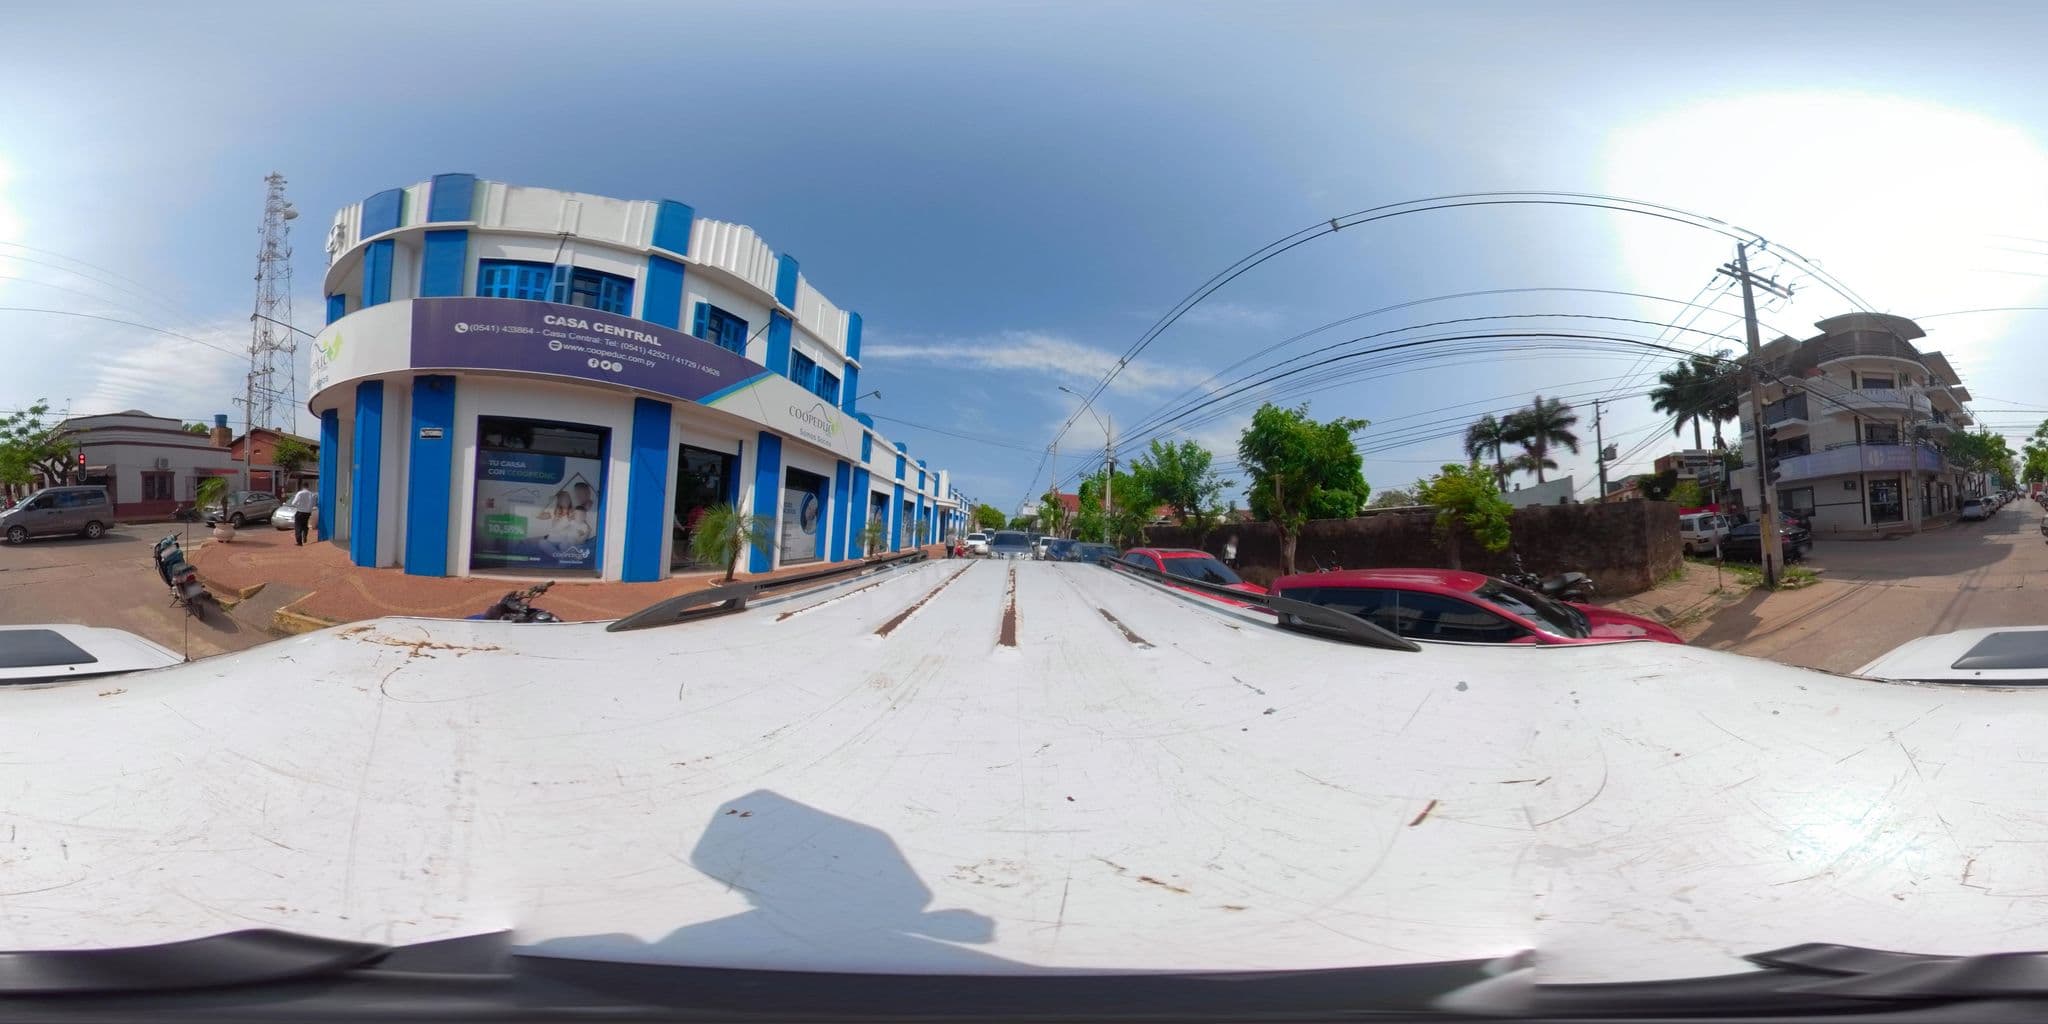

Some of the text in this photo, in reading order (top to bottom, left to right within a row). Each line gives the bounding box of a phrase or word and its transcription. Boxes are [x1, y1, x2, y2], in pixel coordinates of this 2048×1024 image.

[469, 323, 500, 334] (0541)
[542, 329, 566, 339] Casa
[620, 342, 646, 356] (0541)
[544, 315, 661, 346] CASA CENTRAL
[563, 343, 657, 368] www.coopeduc.com.py
